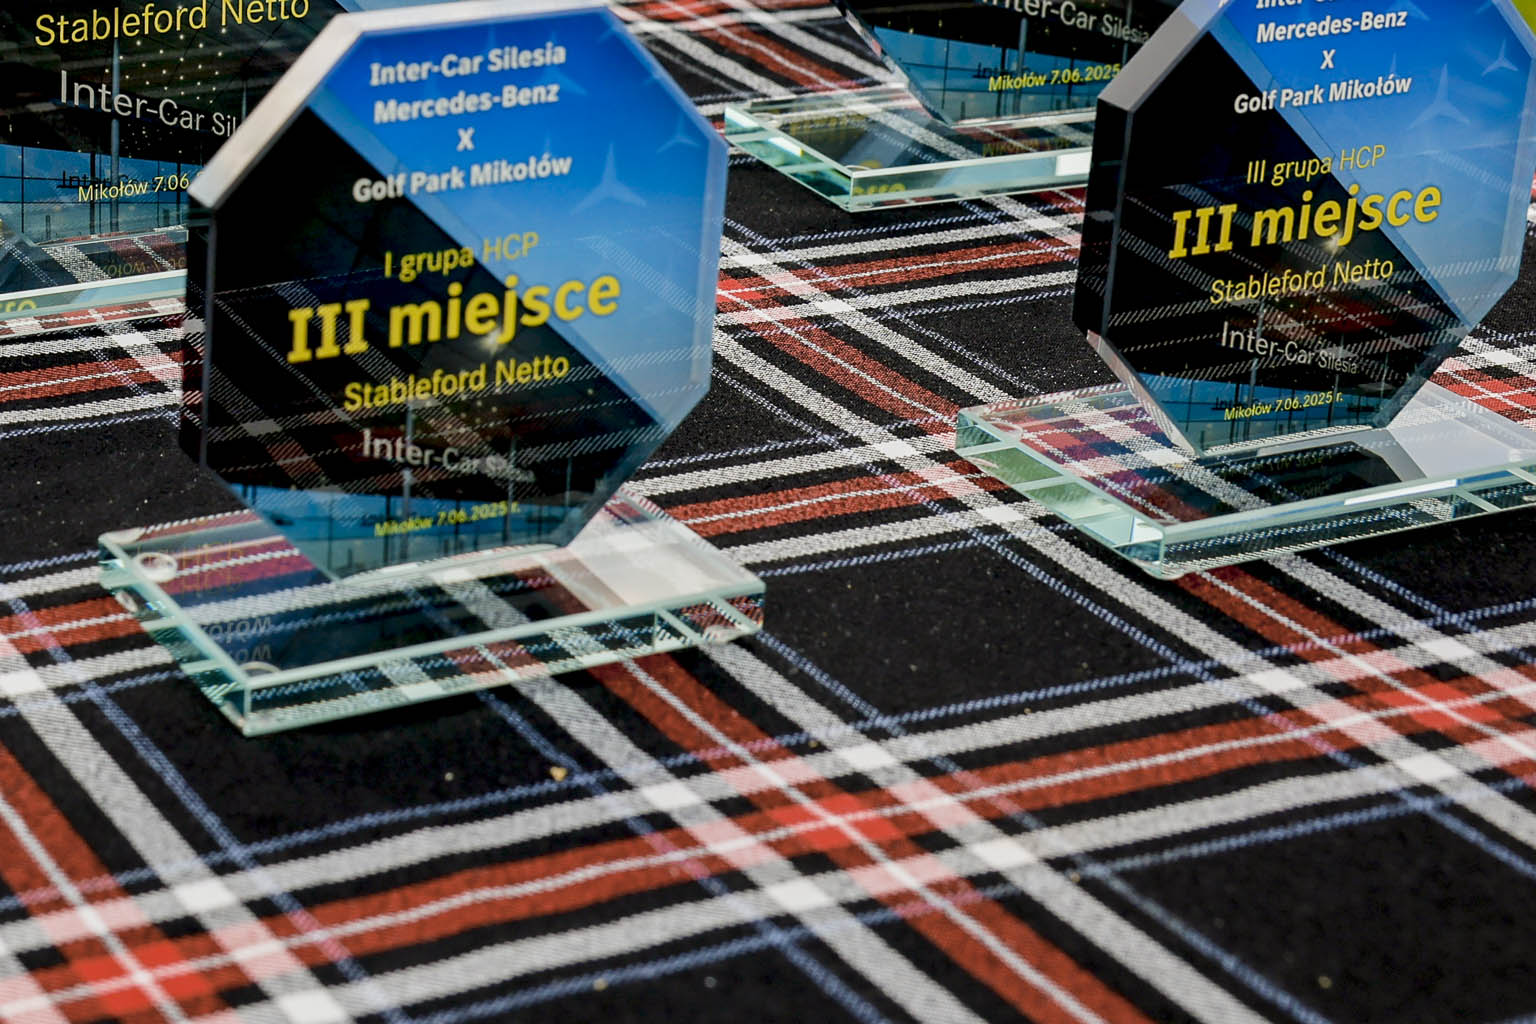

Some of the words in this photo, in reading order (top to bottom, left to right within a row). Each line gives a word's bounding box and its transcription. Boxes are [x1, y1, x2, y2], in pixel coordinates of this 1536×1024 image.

[1256, 11, 1408, 43] Mercedes-Benz
[370, 54, 484, 86] Inter-Car
[488, 41, 566, 72] Silesia
[988, 72, 1047, 92] Mikołów
[61, 69, 205, 131] Inter-Car
[373, 83, 560, 124] Mercedes-Benz
[1234, 89, 1276, 114] Golf
[1279, 84, 1324, 108] Park
[1328, 74, 1412, 102] Mikołów
[352, 173, 407, 203] Golf
[411, 166, 465, 195] Park
[470, 152, 572, 187] Mikołów
[1246, 159, 1266, 184] III
[1271, 156, 1332, 186] grupa
[1339, 144, 1386, 171] HCP
[78, 179, 148, 202] Mikołów
[1168, 203, 1237, 259] III
[1250, 183, 1442, 247] miejsce
[384, 251, 392, 278] I
[399, 246, 474, 282] grupa
[483, 231, 539, 263] HCP
[1209, 264, 1326, 305] Stableford
[1333, 258, 1393, 285] Netto
[287, 298, 370, 364] III
[389, 274, 620, 348] miejsce
[1221, 321, 1315, 365] Inter-Car
[1318, 350, 1358, 374] Silesia
[344, 363, 486, 412] Stableford
[495, 355, 570, 388] Netto
[1224, 403, 1272, 421] Mikołów
[1275, 391, 1333, 413] 7.06.2025
[363, 427, 479, 474] Inter-Car
